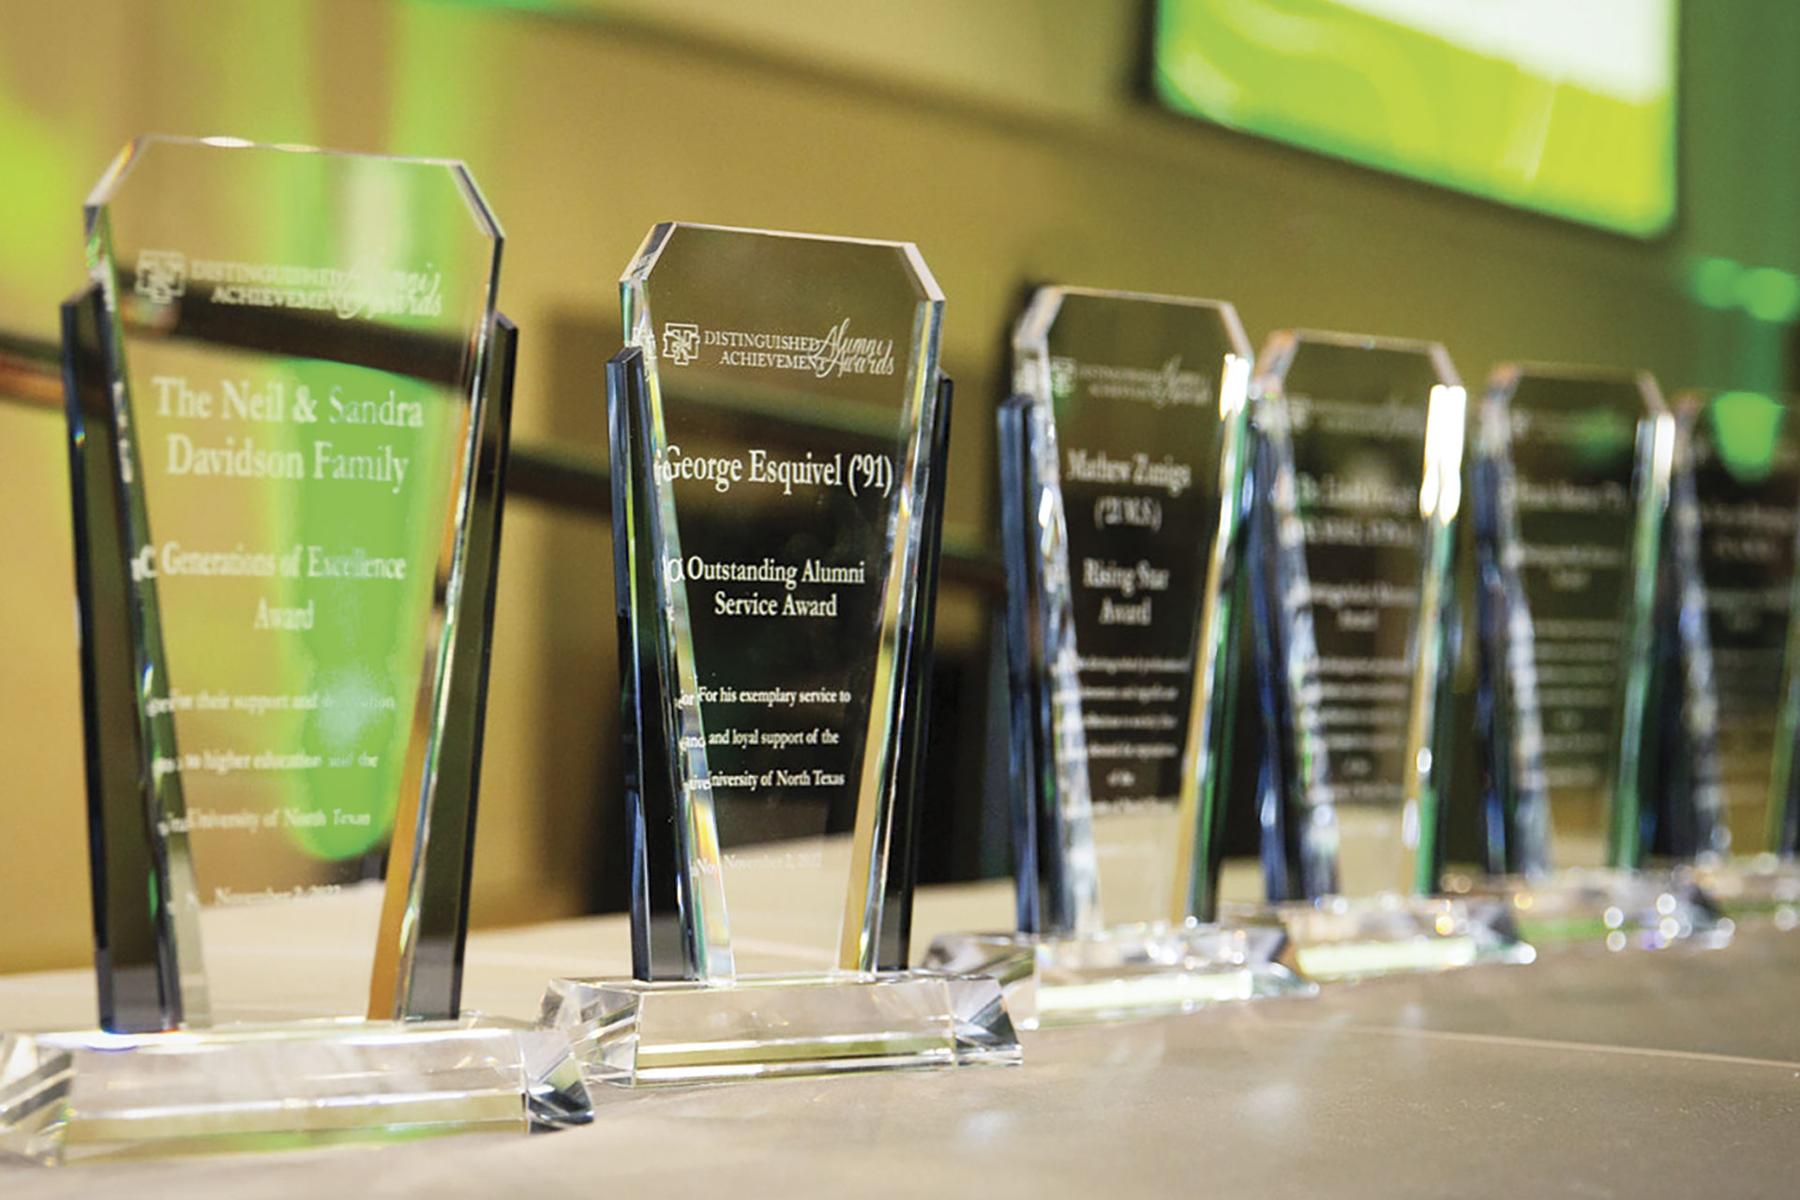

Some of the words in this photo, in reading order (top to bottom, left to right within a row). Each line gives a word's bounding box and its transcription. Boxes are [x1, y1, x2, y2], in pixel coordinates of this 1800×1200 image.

[704, 330, 820, 351] DISTINGUISHED
[720, 351, 827, 372] ACHIEVEMENT
[152, 376, 213, 418] The
[220, 378, 285, 422] Neil
[292, 384, 318, 423] &
[328, 385, 424, 428] Sandra
[166, 432, 305, 480] Davidson
[313, 440, 411, 494] Family
[665, 444, 743, 492] George
[748, 449, 842, 495] Esquivel
[848, 452, 894, 498] ('91)
[162, 541, 276, 577] Generations
[280, 545, 303, 578] of
[307, 545, 406, 580] Excellence
[687, 556, 798, 590] Outstanding
[801, 559, 866, 584] Alumni
[253, 597, 315, 631] Award
[714, 591, 779, 616] Service
[782, 593, 838, 617] Award
[233, 693, 289, 717] support
[292, 690, 318, 710] and
[698, 686, 718, 703] For
[719, 686, 737, 703] his
[739, 687, 796, 708] exemplary
[799, 687, 838, 703] service
[840, 689, 852, 703] to
[708, 729, 730, 745] and
[732, 729, 759, 749] loyal
[761, 731, 804, 749] support
[806, 729, 820, 745] of
[821, 729, 840, 745] the
[253, 749, 323, 770] education
[709, 770, 759, 792] niversity
[760, 770, 775, 787] of
[776, 770, 812, 787] North
[812, 770, 846, 787] Texas
[283, 807, 327, 827] North
